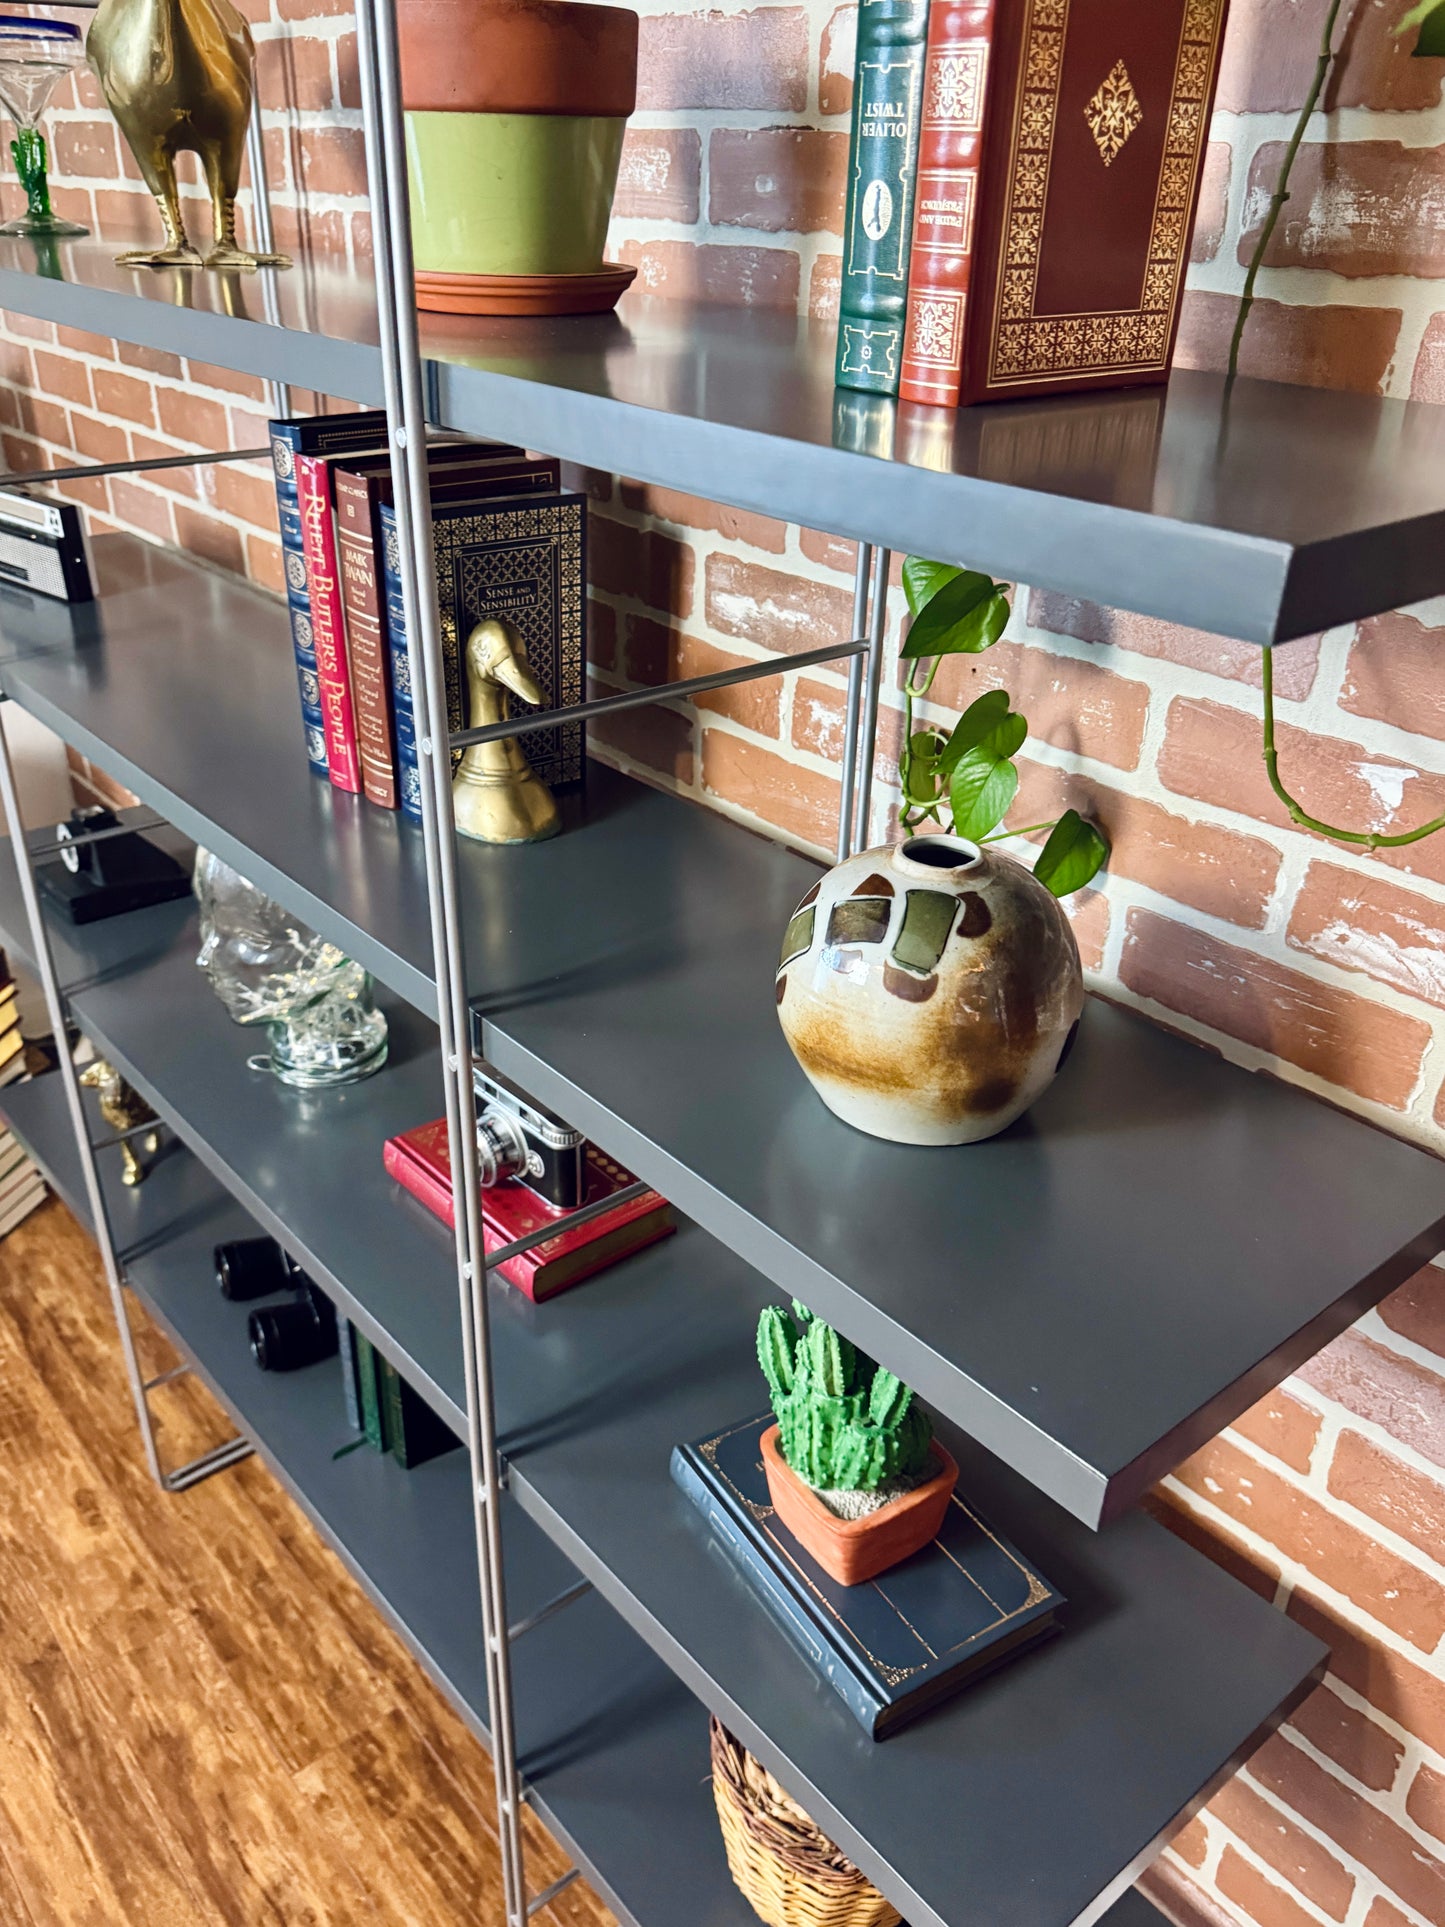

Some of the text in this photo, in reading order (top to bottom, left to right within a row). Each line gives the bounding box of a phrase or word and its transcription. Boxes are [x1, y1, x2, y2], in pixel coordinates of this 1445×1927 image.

[865, 102, 904, 118] TWIST
[862, 122, 907, 137] OLIVER
[304, 493, 326, 569] RHETT
[480, 593, 536, 612] SENSIBILITY
[486, 586, 531, 600] SENSE AND
[313, 574, 337, 673] BUTLER'S
[325, 679, 347, 755] PEOPLE
